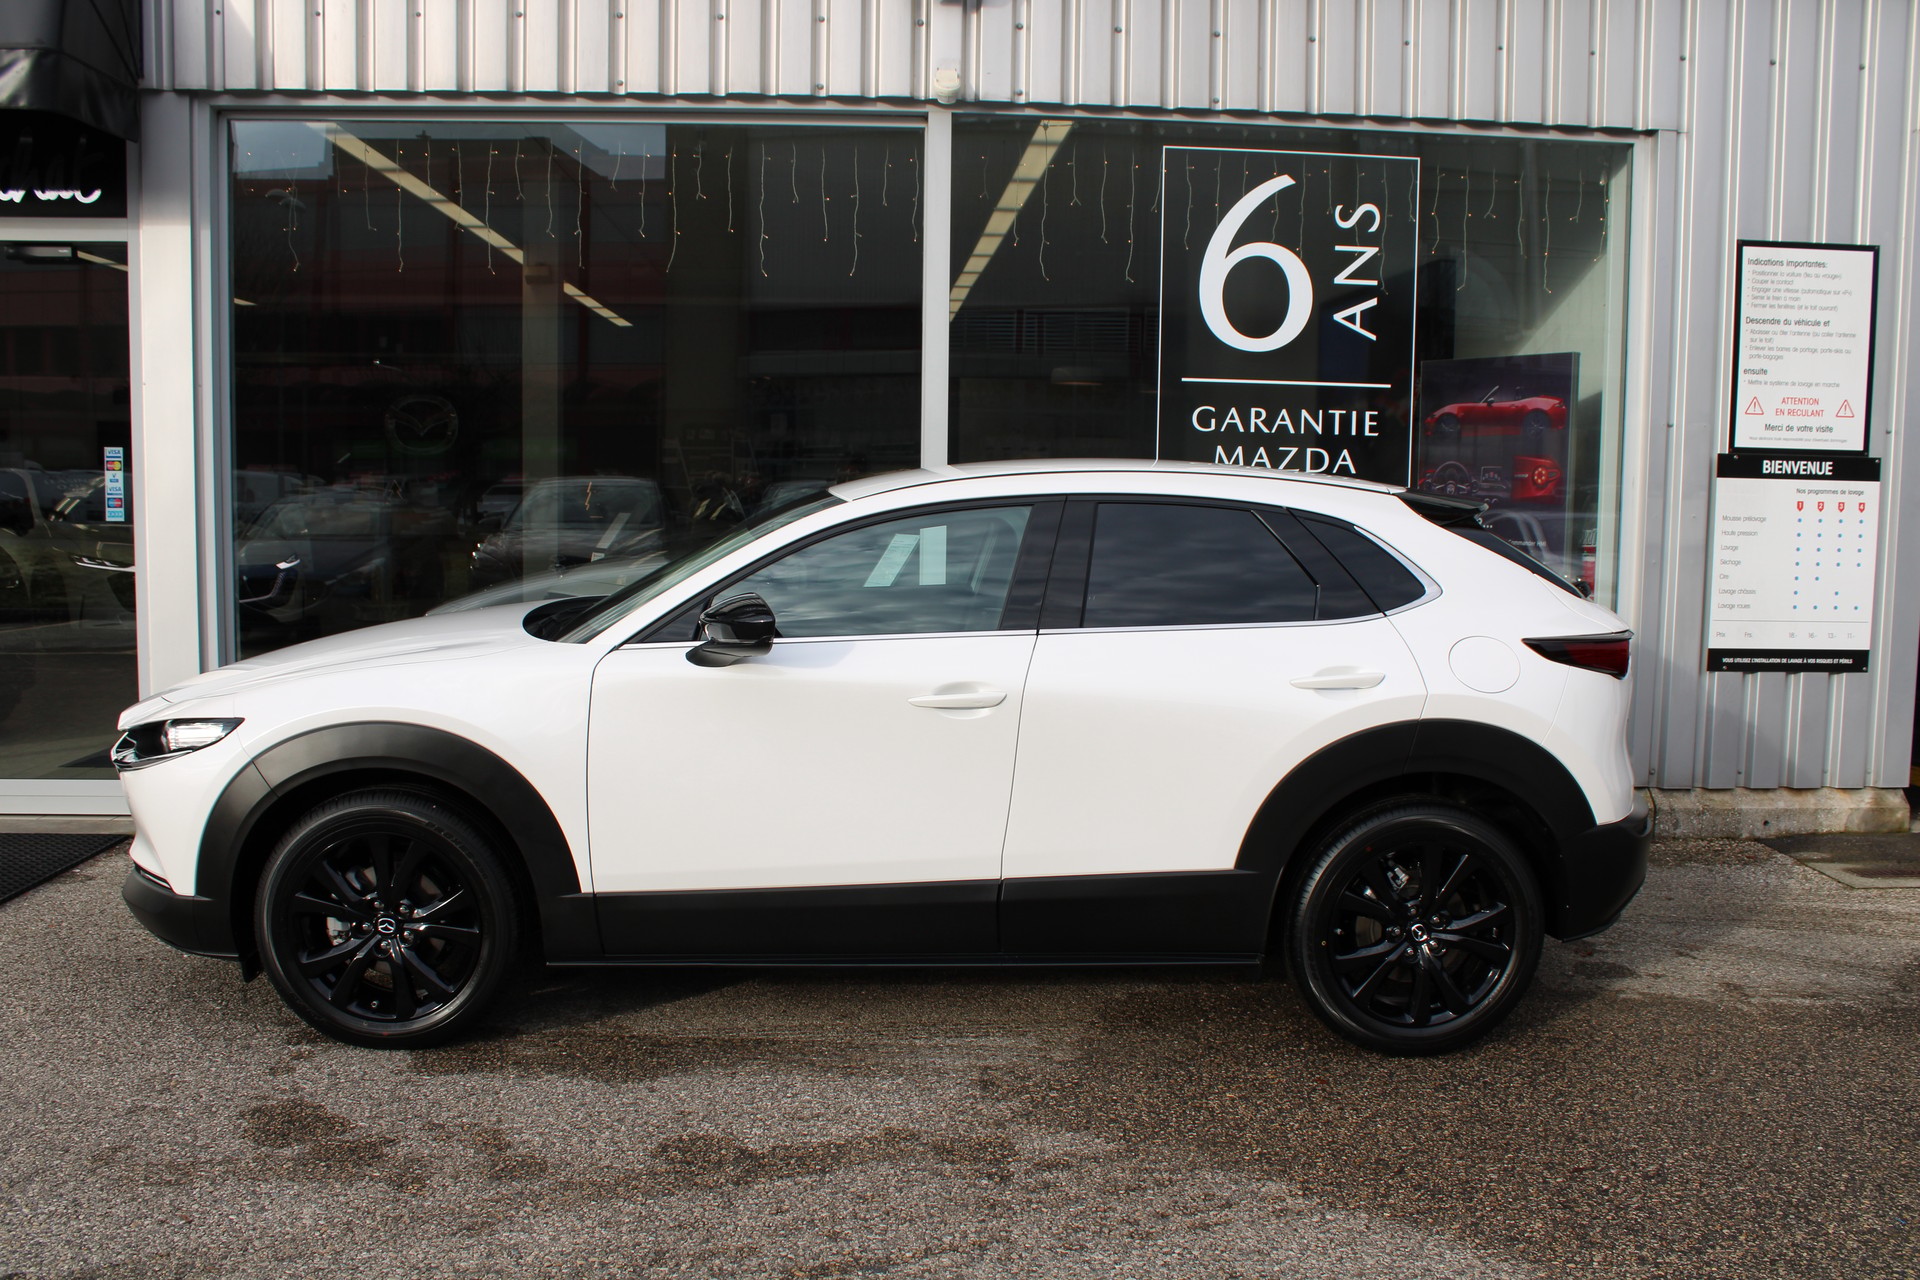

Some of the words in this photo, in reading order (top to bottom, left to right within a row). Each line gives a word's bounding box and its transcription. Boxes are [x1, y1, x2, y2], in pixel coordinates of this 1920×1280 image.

[1199, 174, 1313, 352] 6
[1333, 203, 1381, 341] ANS
[1748, 258, 1784, 266] Indications
[1786, 259, 1828, 268] importantes:
[1746, 317, 1780, 325] Descendre
[1794, 318, 1820, 326] véhicule
[1775, 408, 1784, 416] EN
[1788, 409, 1824, 417] RECULANT
[1191, 405, 1380, 436] GARANTIE
[1765, 424, 1783, 432] Merci
[1816, 425, 1833, 433] visite
[1215, 444, 1356, 474] MAZDA
[1763, 460, 1833, 475] BIENVENUE
